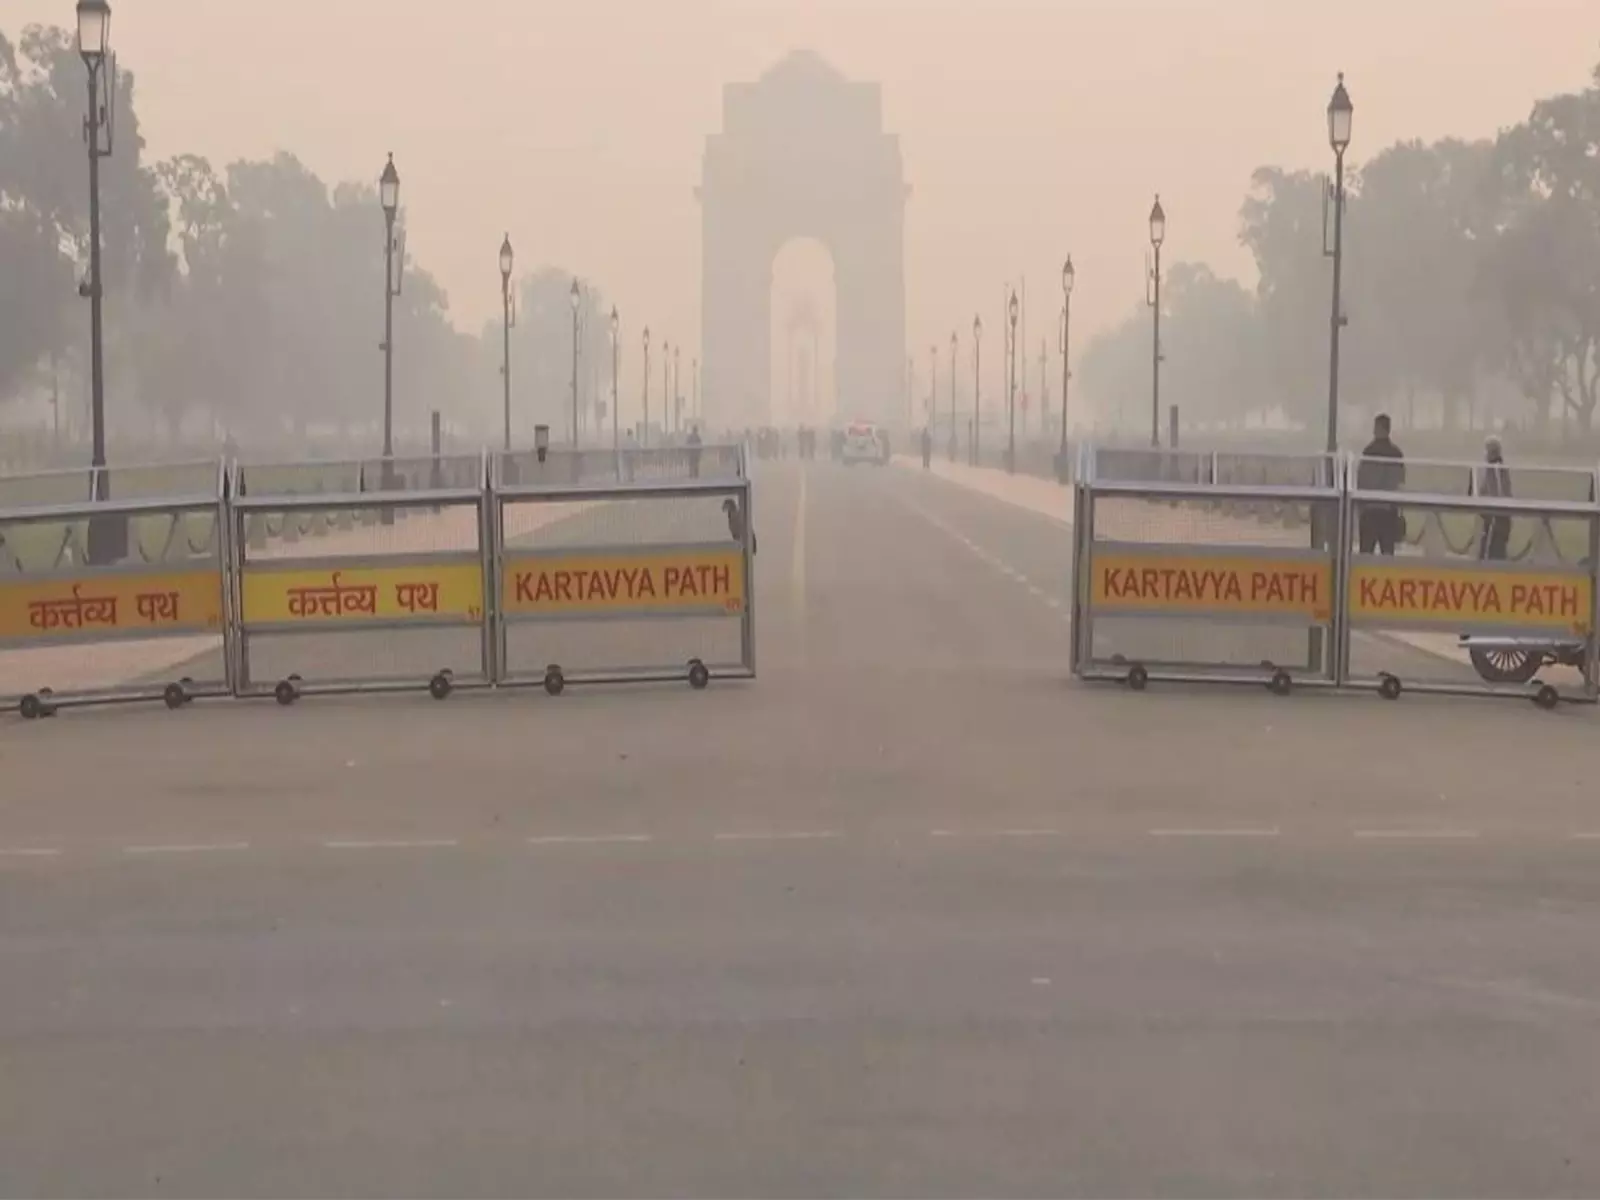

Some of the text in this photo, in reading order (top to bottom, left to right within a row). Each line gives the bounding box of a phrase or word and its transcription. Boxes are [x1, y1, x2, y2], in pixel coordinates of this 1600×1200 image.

[395, 582, 439, 612] पथ
[516, 564, 730, 603] KARTAVYA PATH
[1104, 567, 1317, 603] KARTAVYA PATH
[1360, 576, 1578, 616] KARTAVYA PATH
[136, 591, 180, 621] पथ
